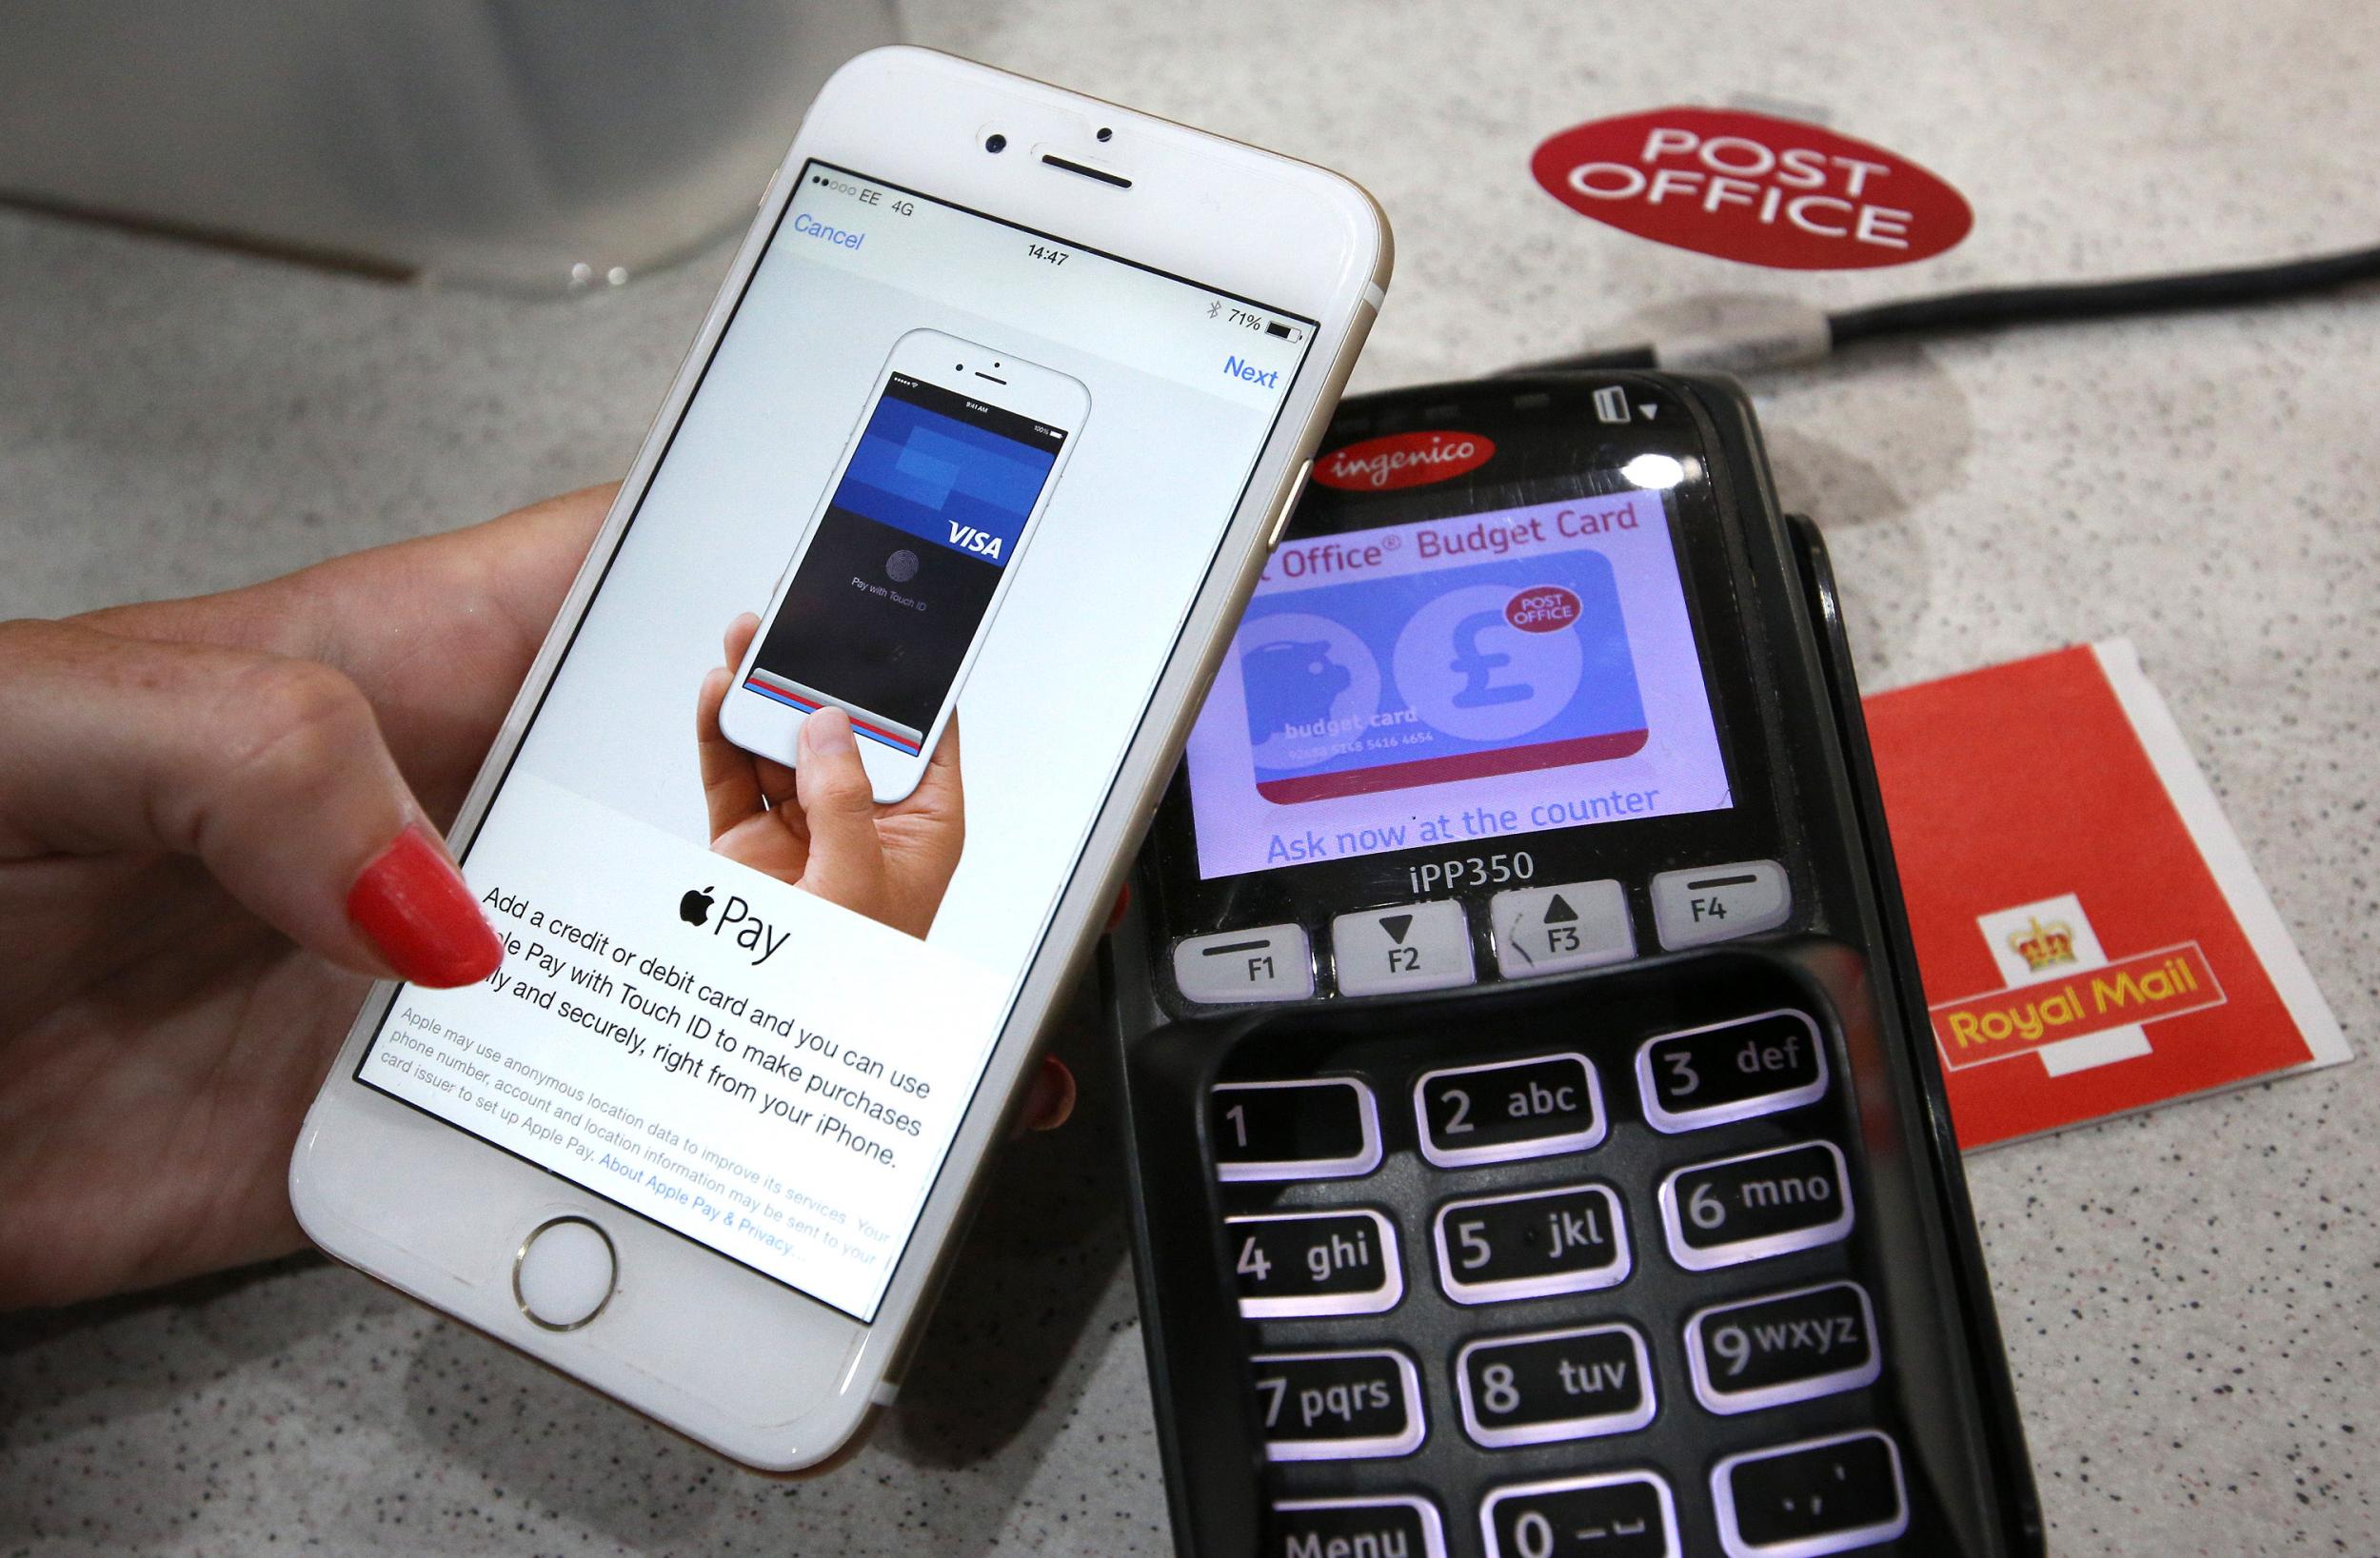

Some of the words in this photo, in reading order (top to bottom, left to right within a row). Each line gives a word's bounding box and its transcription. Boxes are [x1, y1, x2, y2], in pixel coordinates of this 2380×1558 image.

[1642, 127, 1891, 197] POST
[859, 188, 882, 206] EE
[891, 200, 914, 217] 4G
[1568, 162, 1914, 249] OFFICE
[794, 213, 865, 250] Cancel
[1027, 243, 1069, 266] 14:47
[1227, 307, 1261, 331] 71%
[1224, 354, 1279, 389] Next
[1331, 437, 1477, 486] ingenico
[948, 520, 1003, 560] VISA
[1417, 518, 1545, 560] Budget
[1556, 502, 1639, 539] Card
[851, 577, 868, 591] Pay
[869, 582, 887, 598] with
[888, 589, 914, 610] Touch
[915, 602, 928, 612] ID
[1514, 605, 1574, 624] OFFICE
[1521, 594, 1564, 611] POST
[1285, 715, 1365, 739] budget
[1369, 705, 1418, 728] card
[1266, 826, 1327, 864] Ask
[1337, 825, 1406, 856] now
[1418, 812, 1453, 843] at
[1461, 806, 1518, 838] the
[1531, 786, 1660, 824] counter
[1409, 851, 1535, 895] iPP350
[714, 895, 791, 966] Pay
[1690, 895, 1728, 923] F4
[1387, 946, 1420, 973] F2
[1547, 927, 1580, 953] F3
[482, 887, 529, 919] Add
[529, 911, 545, 927] a
[548, 918, 610, 956] credit
[612, 947, 637, 967] or
[639, 957, 695, 994] debit
[698, 985, 748, 1016] card
[749, 1007, 795, 1037] and
[794, 1027, 840, 1058] you
[843, 1050, 884, 1079] can
[889, 1070, 931, 1099] use
[1247, 955, 1276, 981] F1
[1949, 986, 2085, 1049] Royal
[2091, 956, 2198, 1015] Mail
[525, 942, 567, 978] Pay
[571, 966, 614, 997] with
[620, 982, 682, 1028] Touch
[685, 1015, 712, 1039] ID
[715, 1028, 738, 1053] to
[742, 1043, 803, 1083] make
[804, 1072, 922, 1137] purchases
[513, 980, 557, 1011] and
[558, 999, 646, 1056] securely,
[652, 1043, 704, 1078] right
[706, 1064, 758, 1103] from
[758, 1093, 814, 1127] your
[815, 1113, 898, 1169] iPhone.
[1663, 1051, 1700, 1096] 3
[1736, 1035, 1802, 1075] def
[401, 1007, 442, 1035] Apple
[444, 1028, 474, 1053] may
[476, 1043, 503, 1063] use
[504, 1054, 585, 1102] anonymous
[586, 1093, 645, 1130] location
[646, 1122, 680, 1146] data
[683, 1137, 699, 1155] to
[701, 1146, 762, 1184] improve
[763, 1173, 782, 1194] its
[856, 1217, 891, 1245] Your
[1225, 1103, 1248, 1148] 1
[1439, 1090, 1475, 1135] 2
[1507, 1080, 1577, 1119] abc
[381, 1051, 413, 1074] card
[413, 1064, 457, 1094] issuer
[457, 1085, 473, 1102] to
[476, 1095, 499, 1114] set
[500, 1108, 520, 1128] up
[520, 1116, 565, 1145] Apple
[565, 1136, 595, 1162] Pay.
[598, 1153, 645, 1184] About
[645, 1174, 689, 1206] Apple
[691, 1195, 722, 1223] Pay
[723, 1211, 736, 1228] &
[389, 1029, 435, 1057] phone
[435, 1050, 490, 1085] number,
[493, 1077, 553, 1114] account
[553, 1106, 584, 1128] and
[585, 1117, 642, 1155] location
[644, 1146, 725, 1195] information
[728, 1189, 762, 1214] may
[764, 1203, 783, 1223] be
[787, 1215, 821, 1239] sent
[823, 1230, 839, 1249] to
[842, 1241, 878, 1266] your
[1689, 1183, 1727, 1229] 6
[1741, 1170, 1831, 1209] mno
[1237, 1236, 1272, 1282] 4
[1307, 1231, 1370, 1282] ghi
[1458, 1220, 1493, 1269] 5
[1546, 1212, 1603, 1259] jkl
[1712, 1327, 1752, 1376] 9
[1754, 1313, 1858, 1357] wxyz
[1256, 1377, 1288, 1428] 7
[1299, 1377, 1391, 1427] pqrs
[1481, 1365, 1520, 1414] 8
[1557, 1356, 1627, 1397] tuv
[1515, 1511, 1554, 1558] 0
